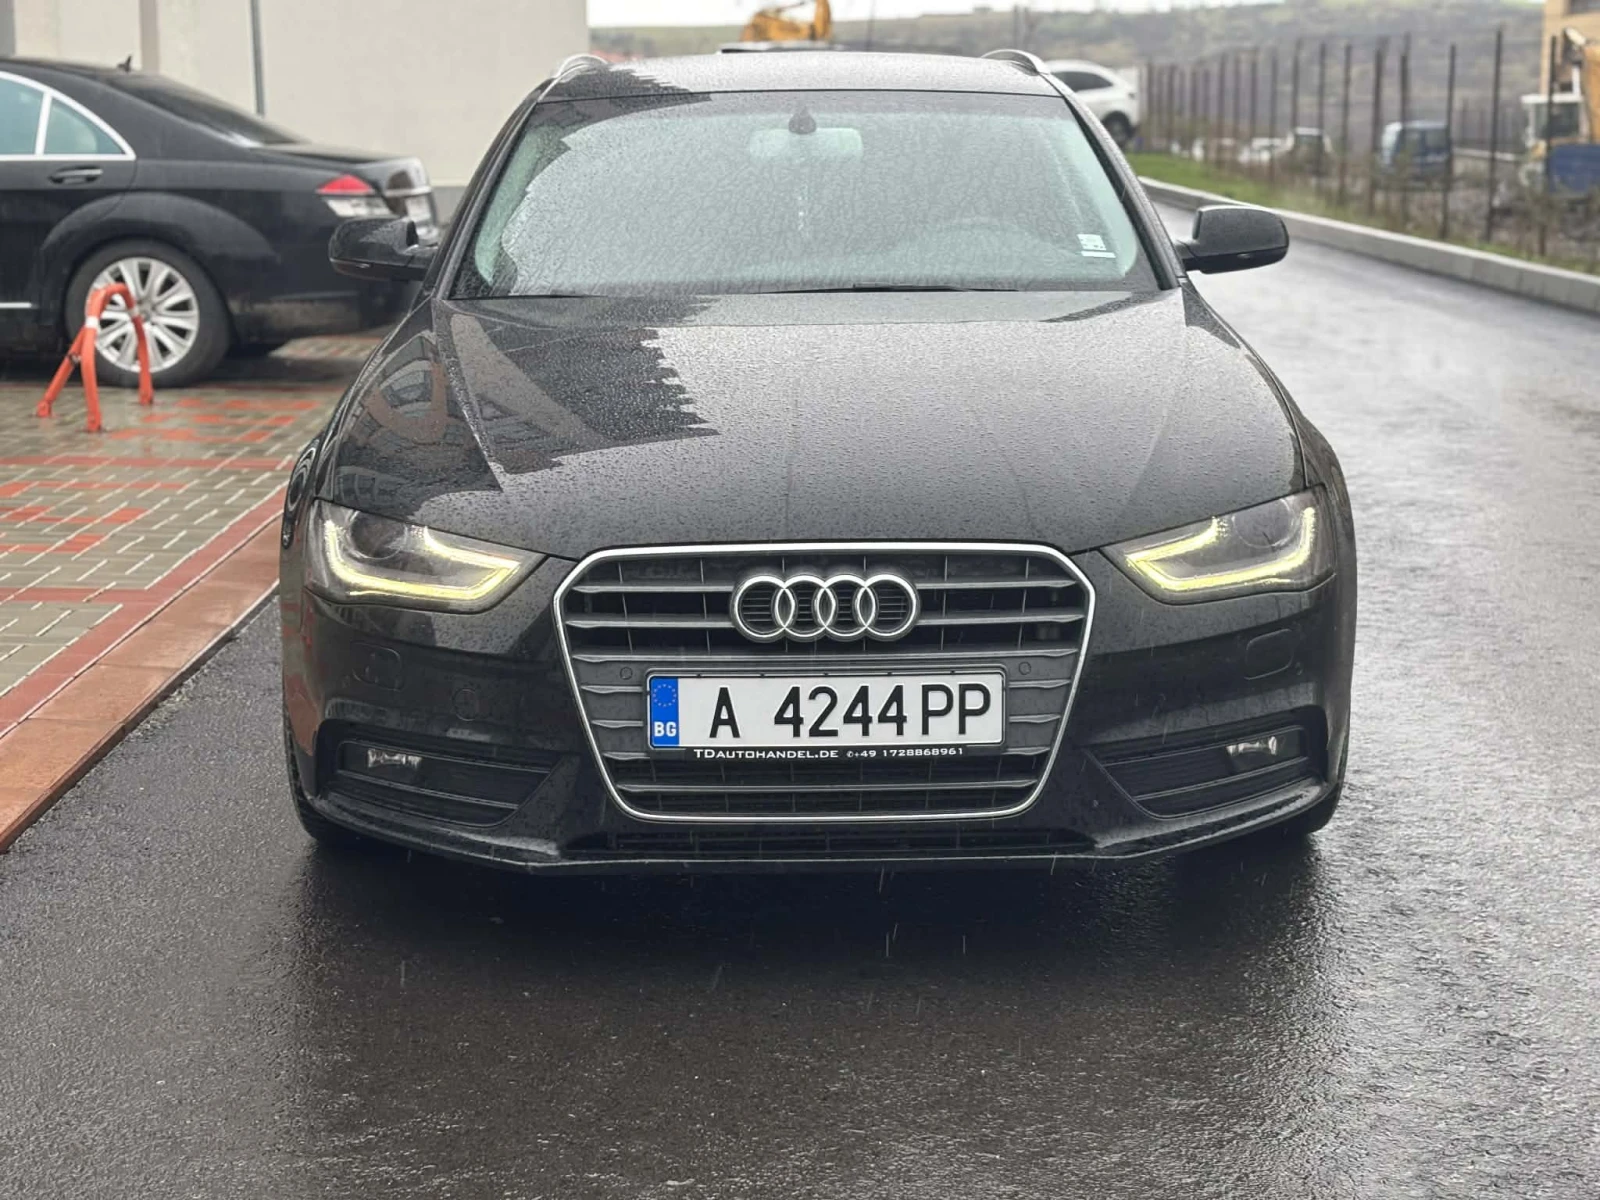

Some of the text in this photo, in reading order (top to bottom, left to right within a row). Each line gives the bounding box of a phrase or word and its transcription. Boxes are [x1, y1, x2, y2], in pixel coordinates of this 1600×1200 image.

[709, 683, 991, 738] A 4244 PP
[654, 721, 677, 737] BG
[694, 749, 838, 759] TDAUTOHANDEL.DE
